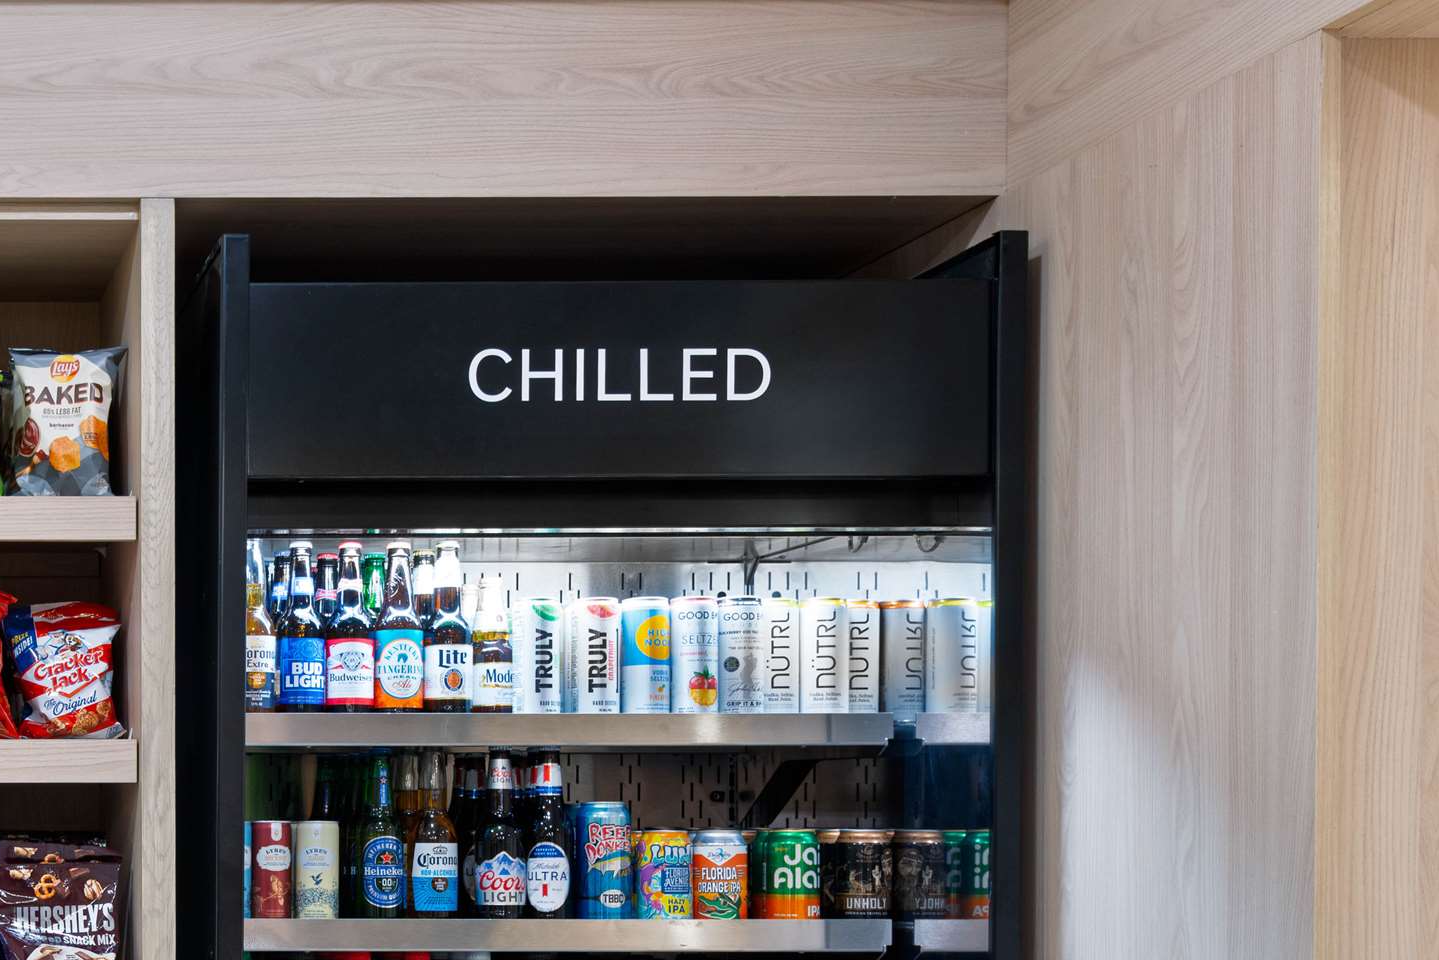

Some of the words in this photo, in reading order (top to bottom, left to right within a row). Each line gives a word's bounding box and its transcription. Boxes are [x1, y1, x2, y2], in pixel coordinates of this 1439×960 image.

[51, 359, 79, 378] Lay's
[468, 347, 771, 401] CHILLED
[24, 382, 103, 406] BAKED
[678, 611, 709, 620] GOOD
[723, 612, 755, 621] GOOD
[765, 612, 790, 689] NÜTRL
[811, 611, 837, 689] NÜTRL
[439, 649, 467, 668] Lite
[535, 628, 553, 693] TRULY
[588, 628, 607, 693] TRULY
[34, 650, 103, 681] Cracker
[291, 662, 323, 675] BUD
[285, 675, 325, 688] LIGHT
[329, 673, 372, 682] Budweiser
[53, 690, 97, 715] Original
[528, 871, 568, 881] ULTRA
[665, 867, 689, 878] FLORIDA
[701, 867, 737, 880] FLORIDA
[698, 882, 728, 893] ORANGE
[728, 882, 740, 893] IPA
[483, 891, 525, 902] LIGHT
[603, 893, 624, 904] TBBC
[668, 905, 686, 914] IPA
[846, 897, 888, 910] UNHOLY
[15, 903, 115, 934] HERSHEY'S
[63, 935, 96, 946] SNACK
[97, 935, 116, 946] MIX
